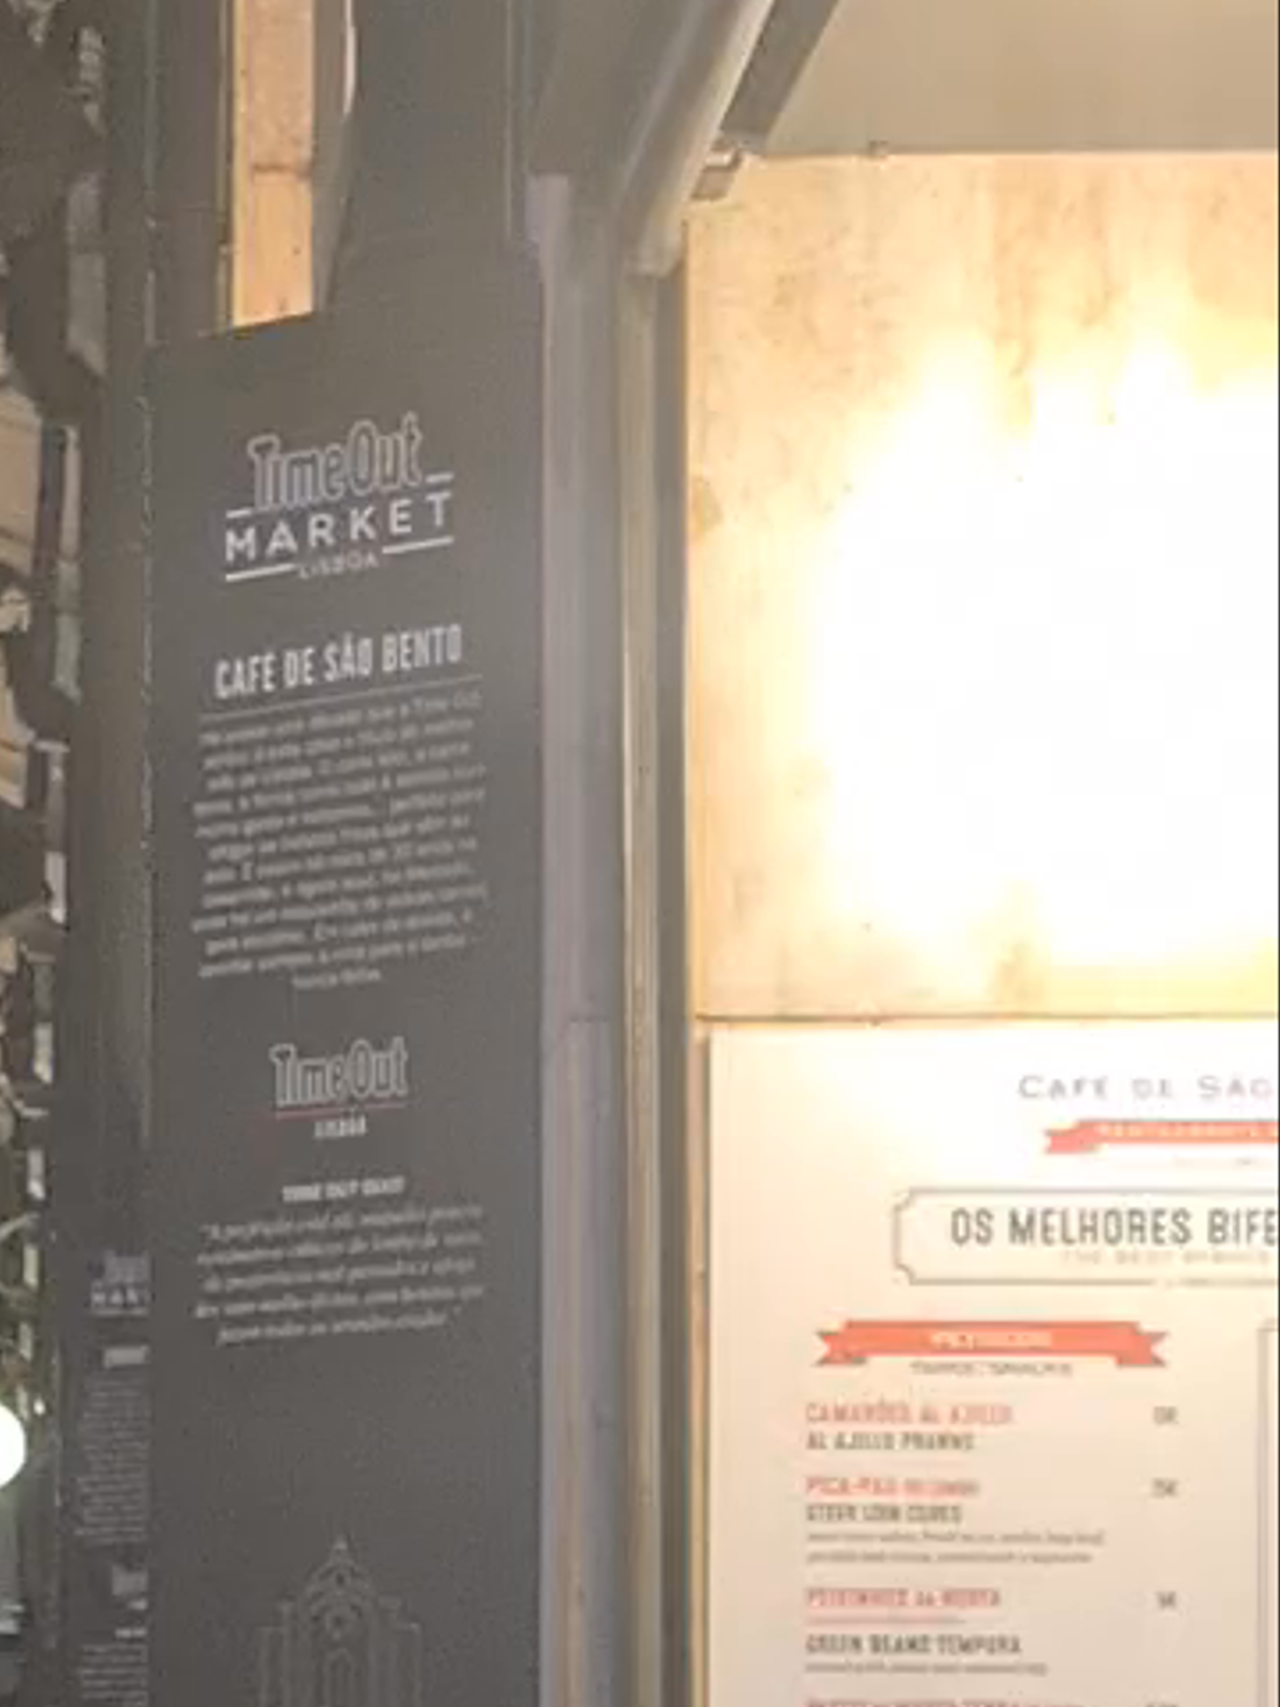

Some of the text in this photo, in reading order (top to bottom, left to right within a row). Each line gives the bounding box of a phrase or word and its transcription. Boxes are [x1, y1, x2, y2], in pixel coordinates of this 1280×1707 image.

[247, 410, 423, 511] Time Out
[225, 490, 453, 563] MARKET
[283, 647, 316, 689] DE
[381, 623, 463, 673] BENTO
[950, 1207, 994, 1246] OS
[1008, 1207, 1193, 1247] MELHORES
